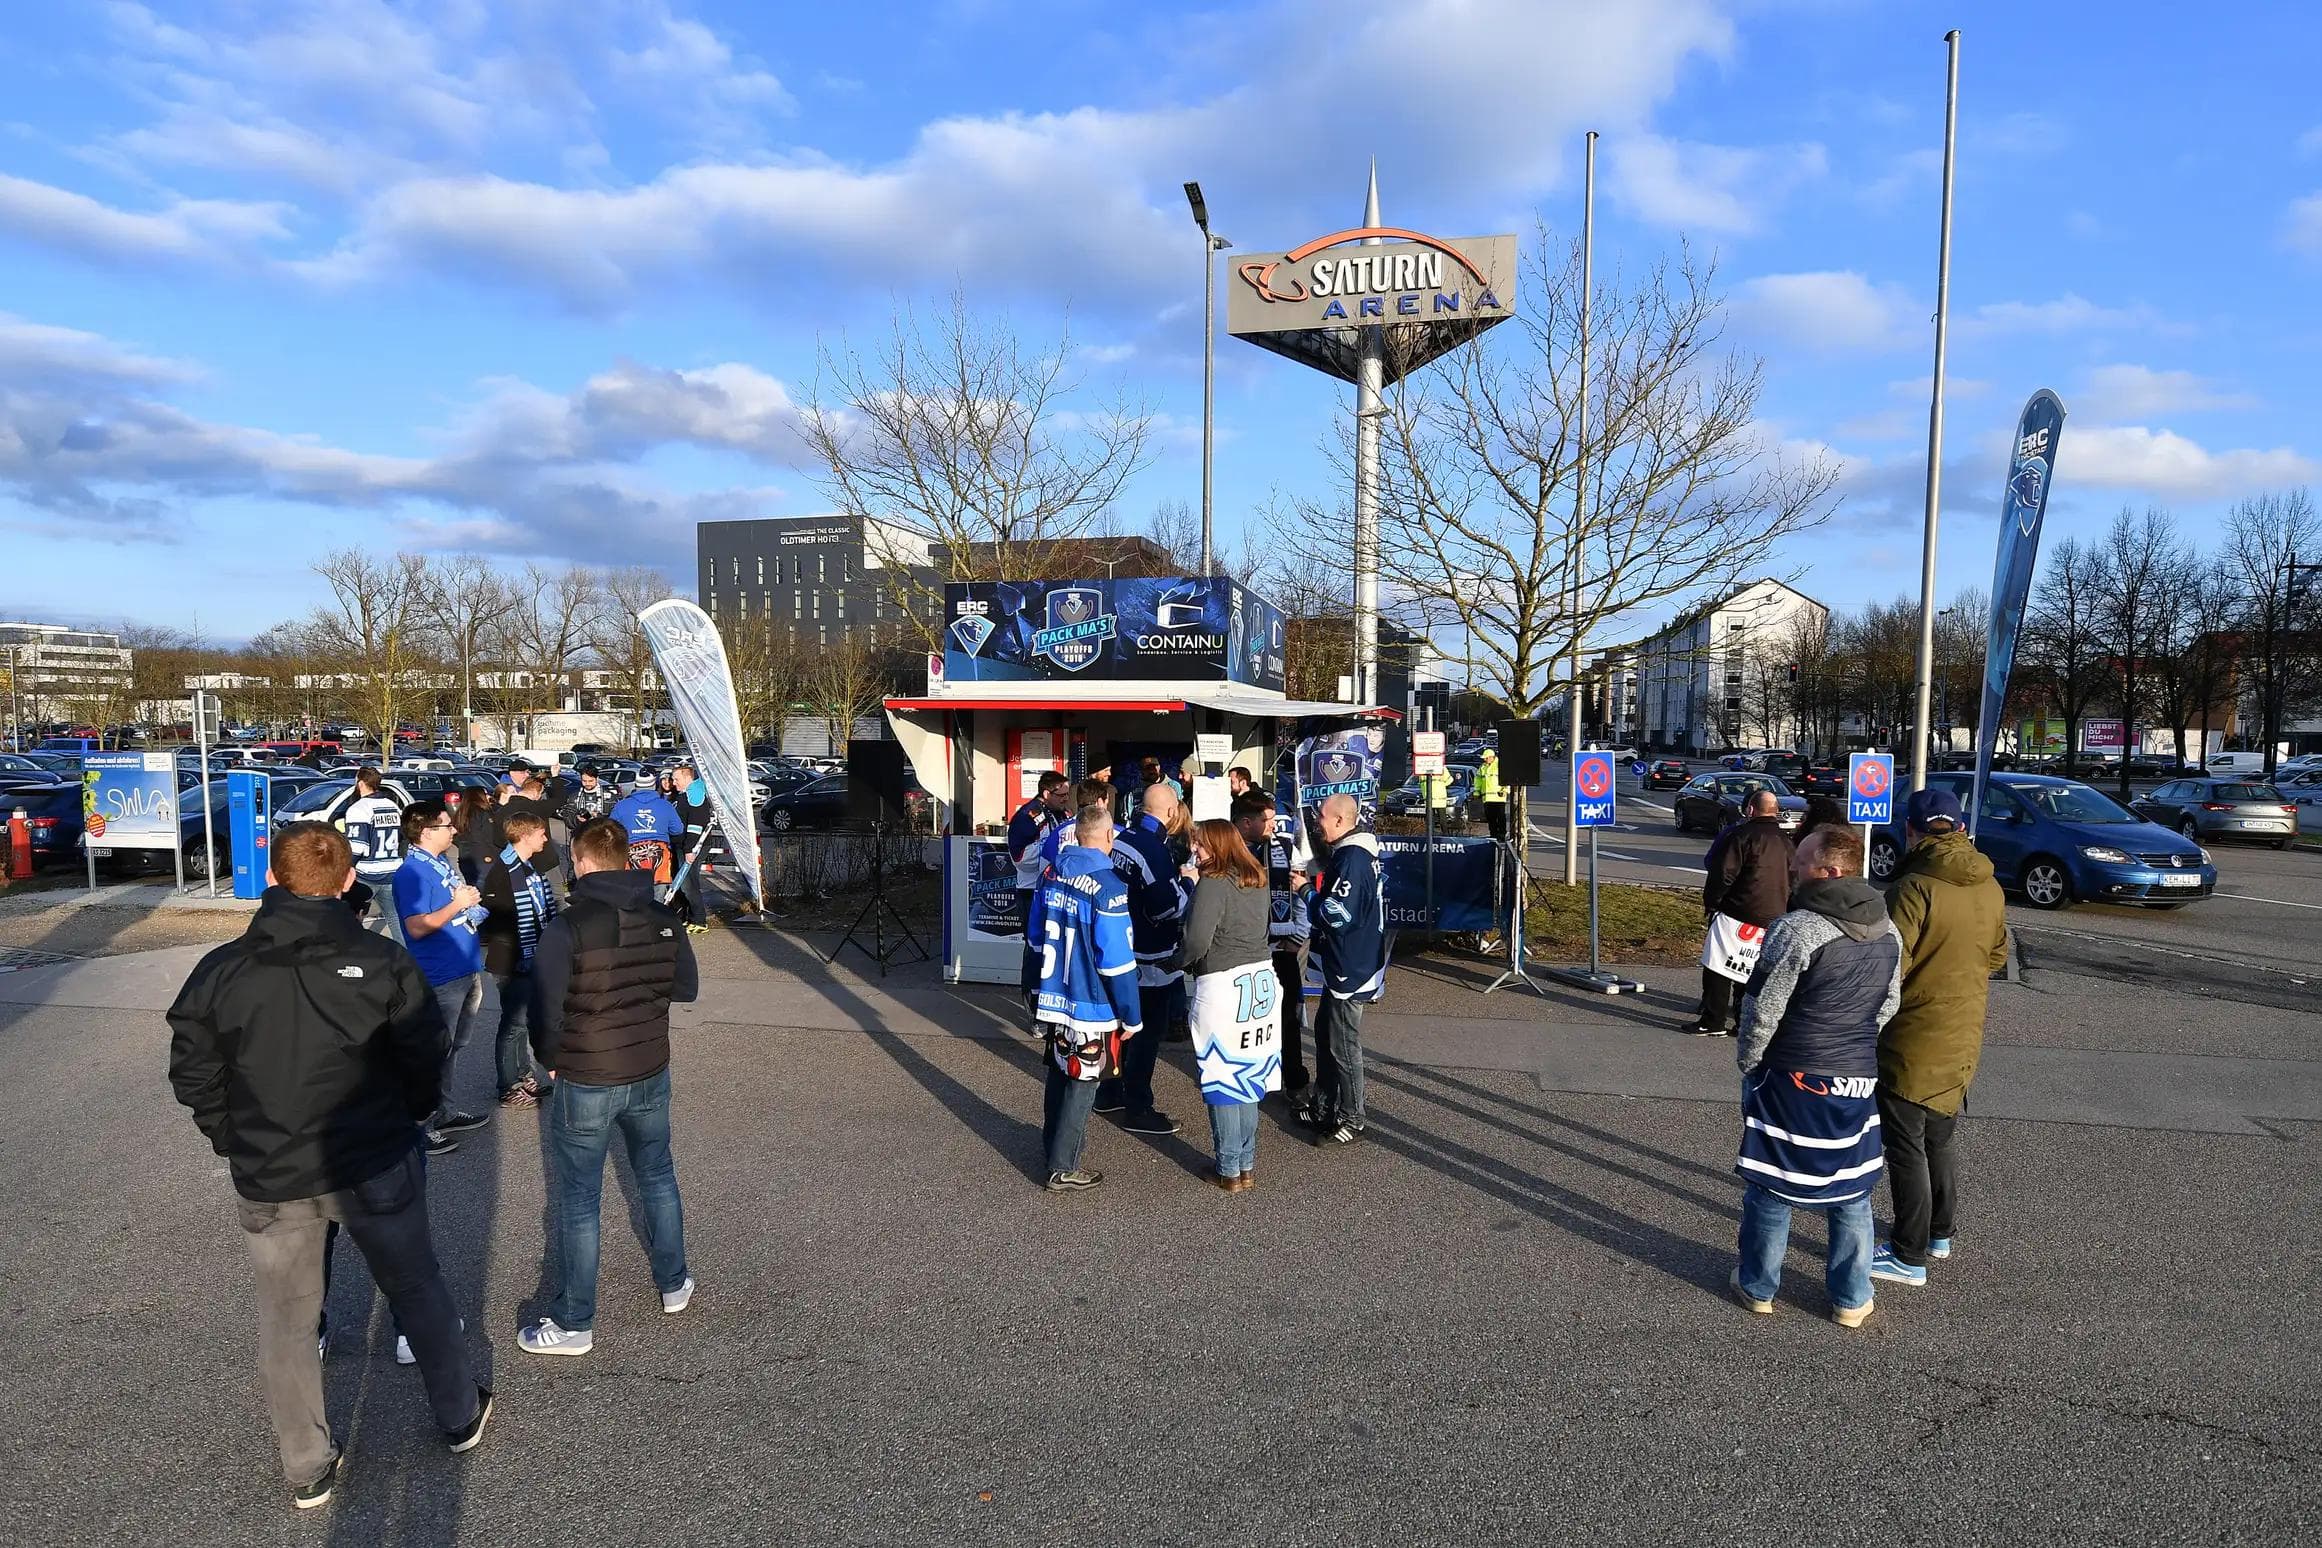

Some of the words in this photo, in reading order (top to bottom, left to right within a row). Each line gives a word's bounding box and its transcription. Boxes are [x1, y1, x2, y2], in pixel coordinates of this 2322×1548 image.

[1312, 251, 1443, 296] SATURN
[1321, 288, 1501, 320] ARENA
[2019, 427, 2049, 454] ERC
[780, 535, 816, 545] OLDTIMER
[956, 600, 988, 611] ERC
[1041, 626, 1073, 645] PACK
[1077, 619, 1107, 637] MA'S
[1054, 644, 1093, 654] PLAYOFFS
[1137, 634, 1223, 649] CONTAINU
[537, 727, 578, 736] packaging
[1306, 784, 1337, 798] PACK
[1339, 780, 1369, 794] MA'S
[1578, 803, 1610, 819] TAXI
[1853, 802, 1887, 817] TAXI
[347, 825, 360, 837] 14
[375, 829, 400, 858] 14
[1378, 842, 1419, 852] ATURN
[976, 881, 1000, 893] PACK
[1234, 969, 1276, 1023] 19
[1240, 1023, 1273, 1049] ERC
